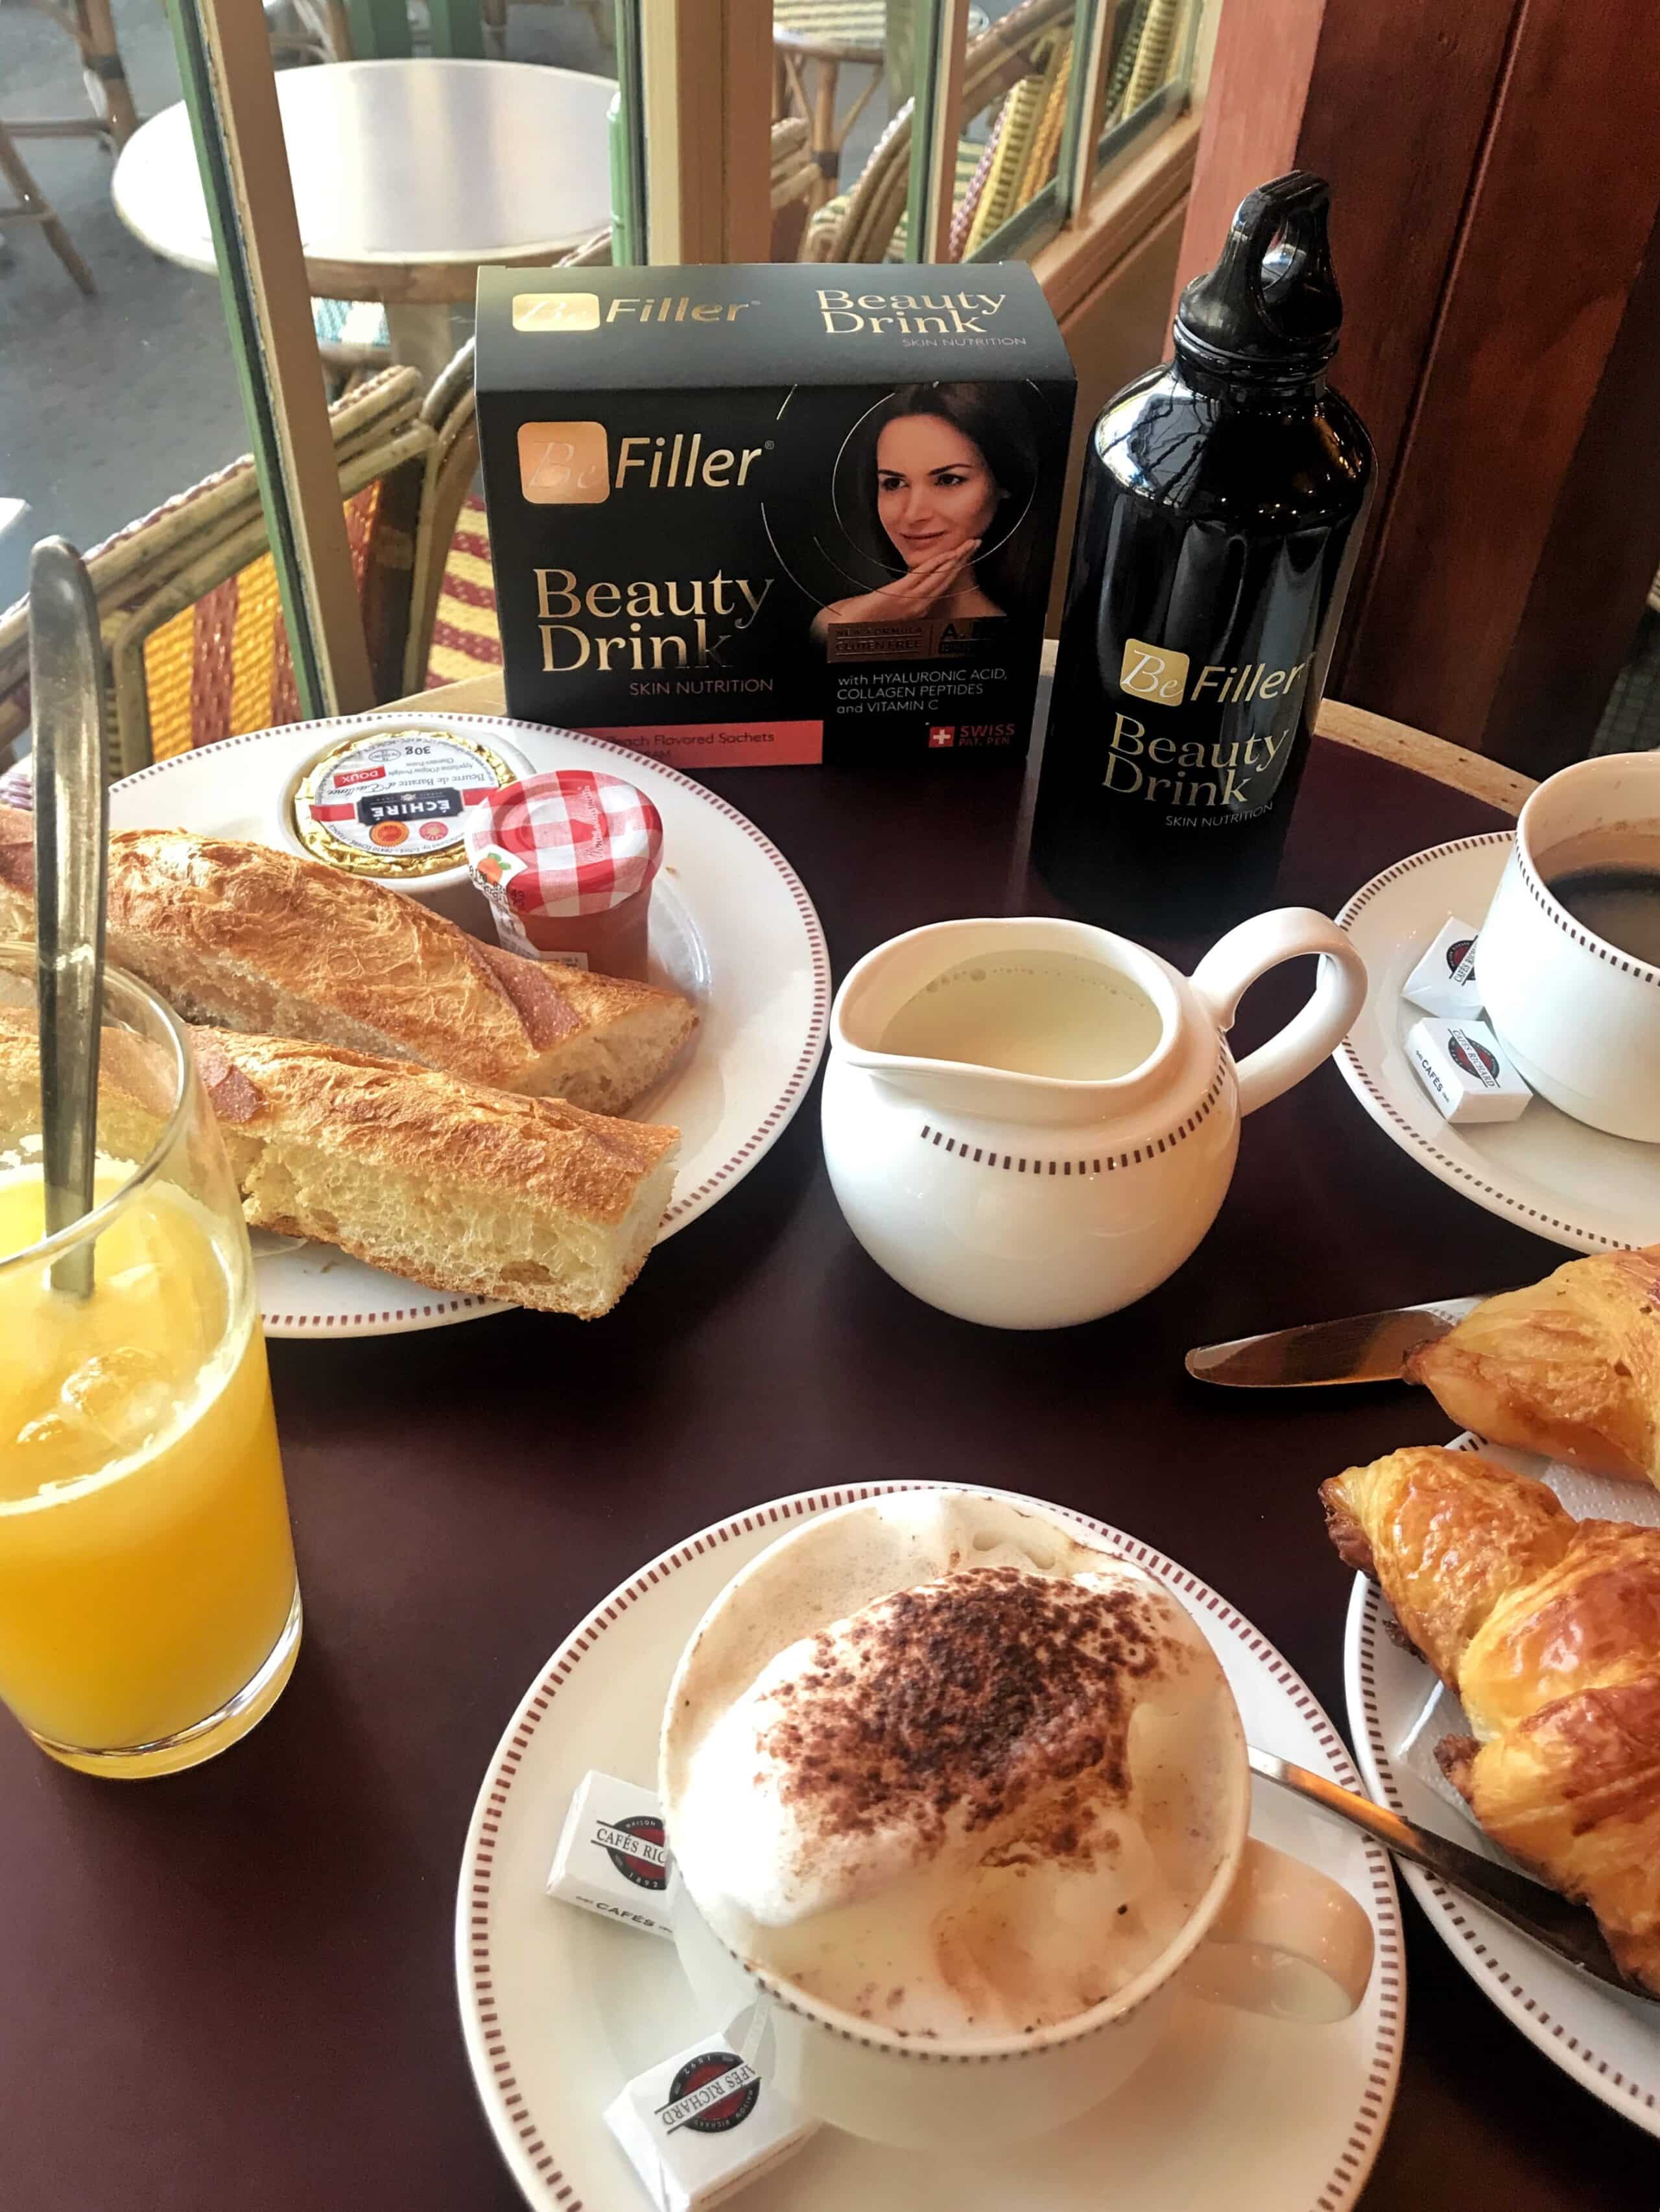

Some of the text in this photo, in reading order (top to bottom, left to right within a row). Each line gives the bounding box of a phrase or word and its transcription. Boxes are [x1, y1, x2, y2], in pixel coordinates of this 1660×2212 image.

[816, 290, 1006, 316] Beauty
[821, 309, 988, 333] Drink
[902, 337, 1027, 347] SKIN NUTRITION
[532, 568, 775, 629] Beauty
[538, 618, 735, 672] Drink
[888, 638, 923, 650] FREE
[838, 668, 1007, 686] with HYALURONIC ACID,
[1121, 650, 1307, 703] Be Filler
[629, 679, 774, 696] SKIN NUTRITION
[836, 683, 984, 700] COLLAGEN PEPTIDES
[836, 700, 939, 714] and VITAMIN C
[654, 733, 714, 746] Flavored
[718, 731, 775, 744] Sachets
[960, 723, 1015, 738] SWISS
[405, 745, 432, 755] 30g
[1110, 712, 1290, 772] Beauty
[341, 770, 379, 784] DOUX
[437, 777, 449, 785] de
[451, 773, 486, 783] Beurre
[1102, 752, 1251, 806] Drink
[370, 799, 451, 821] ÉCHIRÉ
[1165, 803, 1274, 827] SKIN NUTRITION
[1421, 1059, 1444, 1093] CAFÉS
[1467, 1051, 1495, 1088] RICHARD
[625, 1819, 656, 1828] MAISON
[596, 1828, 639, 1853] CAFÉS
[628, 1872, 658, 1888] 1892
[595, 1902, 656, 1927] CAFÉS
[661, 2081, 726, 2126] RICHARD
